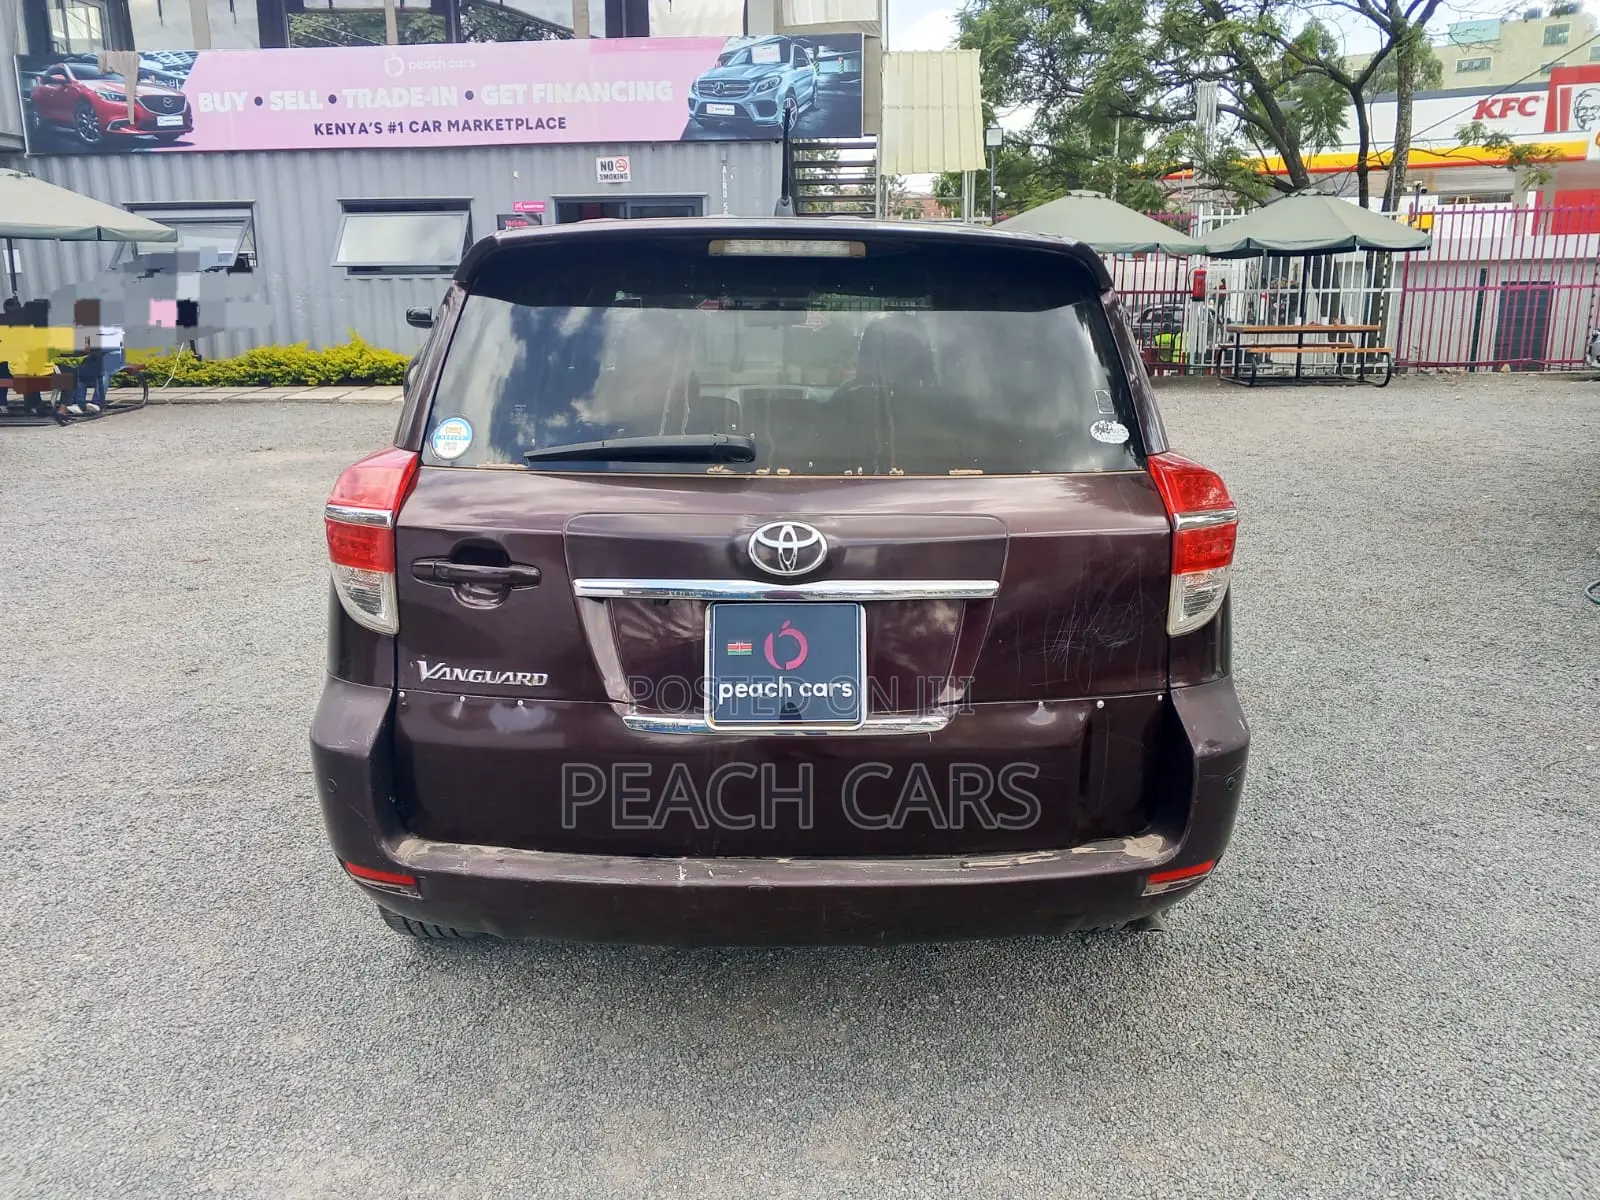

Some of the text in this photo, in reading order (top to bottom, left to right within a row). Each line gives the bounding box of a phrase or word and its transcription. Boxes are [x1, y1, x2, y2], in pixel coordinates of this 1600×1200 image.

[408, 57, 476, 73] peach cars
[198, 80, 674, 113] BUY SELL TRADE-IN GET FINANCING
[1472, 95, 1541, 120] KFC
[313, 116, 567, 136] KENYA'S #1 CAR MARKETPLACE
[600, 160, 614, 171] NO
[599, 173, 628, 181] SMOKING
[416, 660, 549, 687] VANGUARD
[718, 675, 853, 705] peach cars
